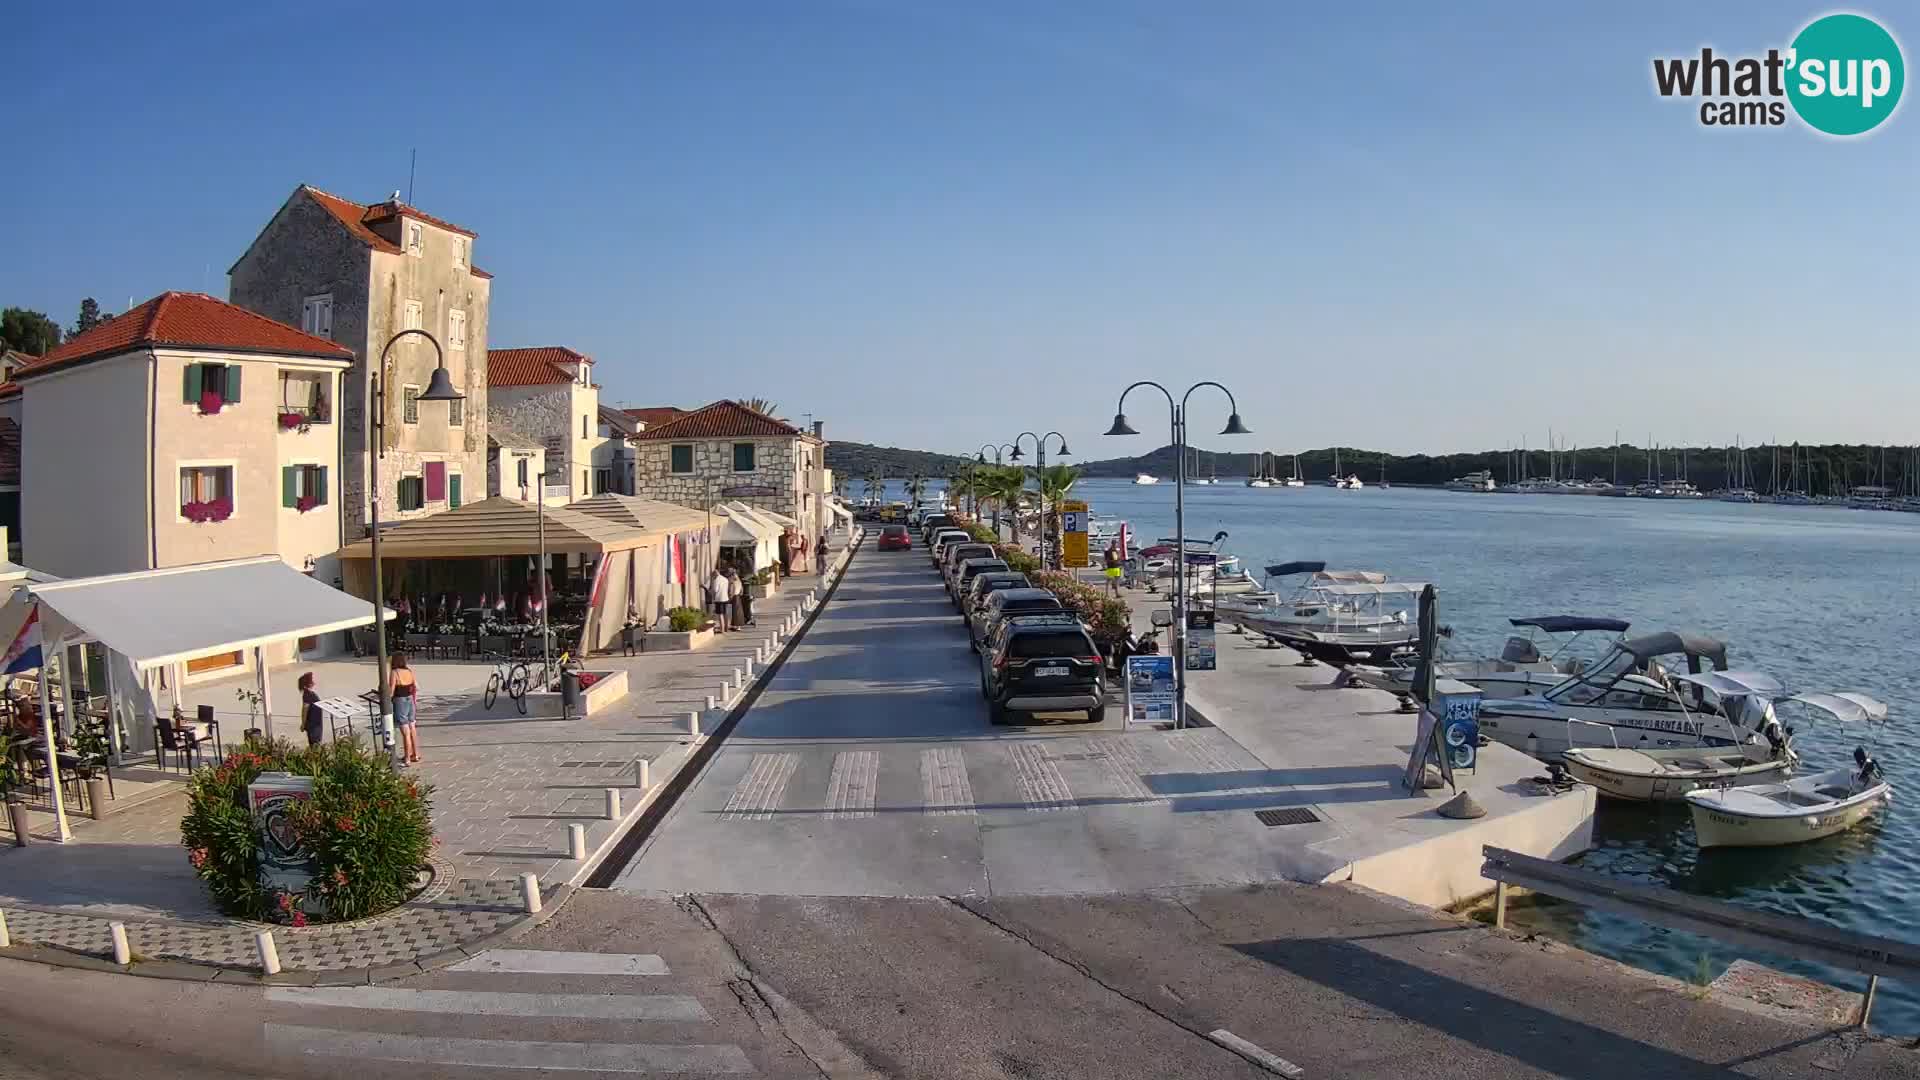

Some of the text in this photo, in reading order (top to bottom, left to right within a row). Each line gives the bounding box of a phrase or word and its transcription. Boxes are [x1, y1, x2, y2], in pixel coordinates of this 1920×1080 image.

[1064, 514, 1076, 531] P
[1447, 700, 1477, 712] RENT
[1654, 719, 1675, 731] RENT
[1675, 720, 1683, 732] A
